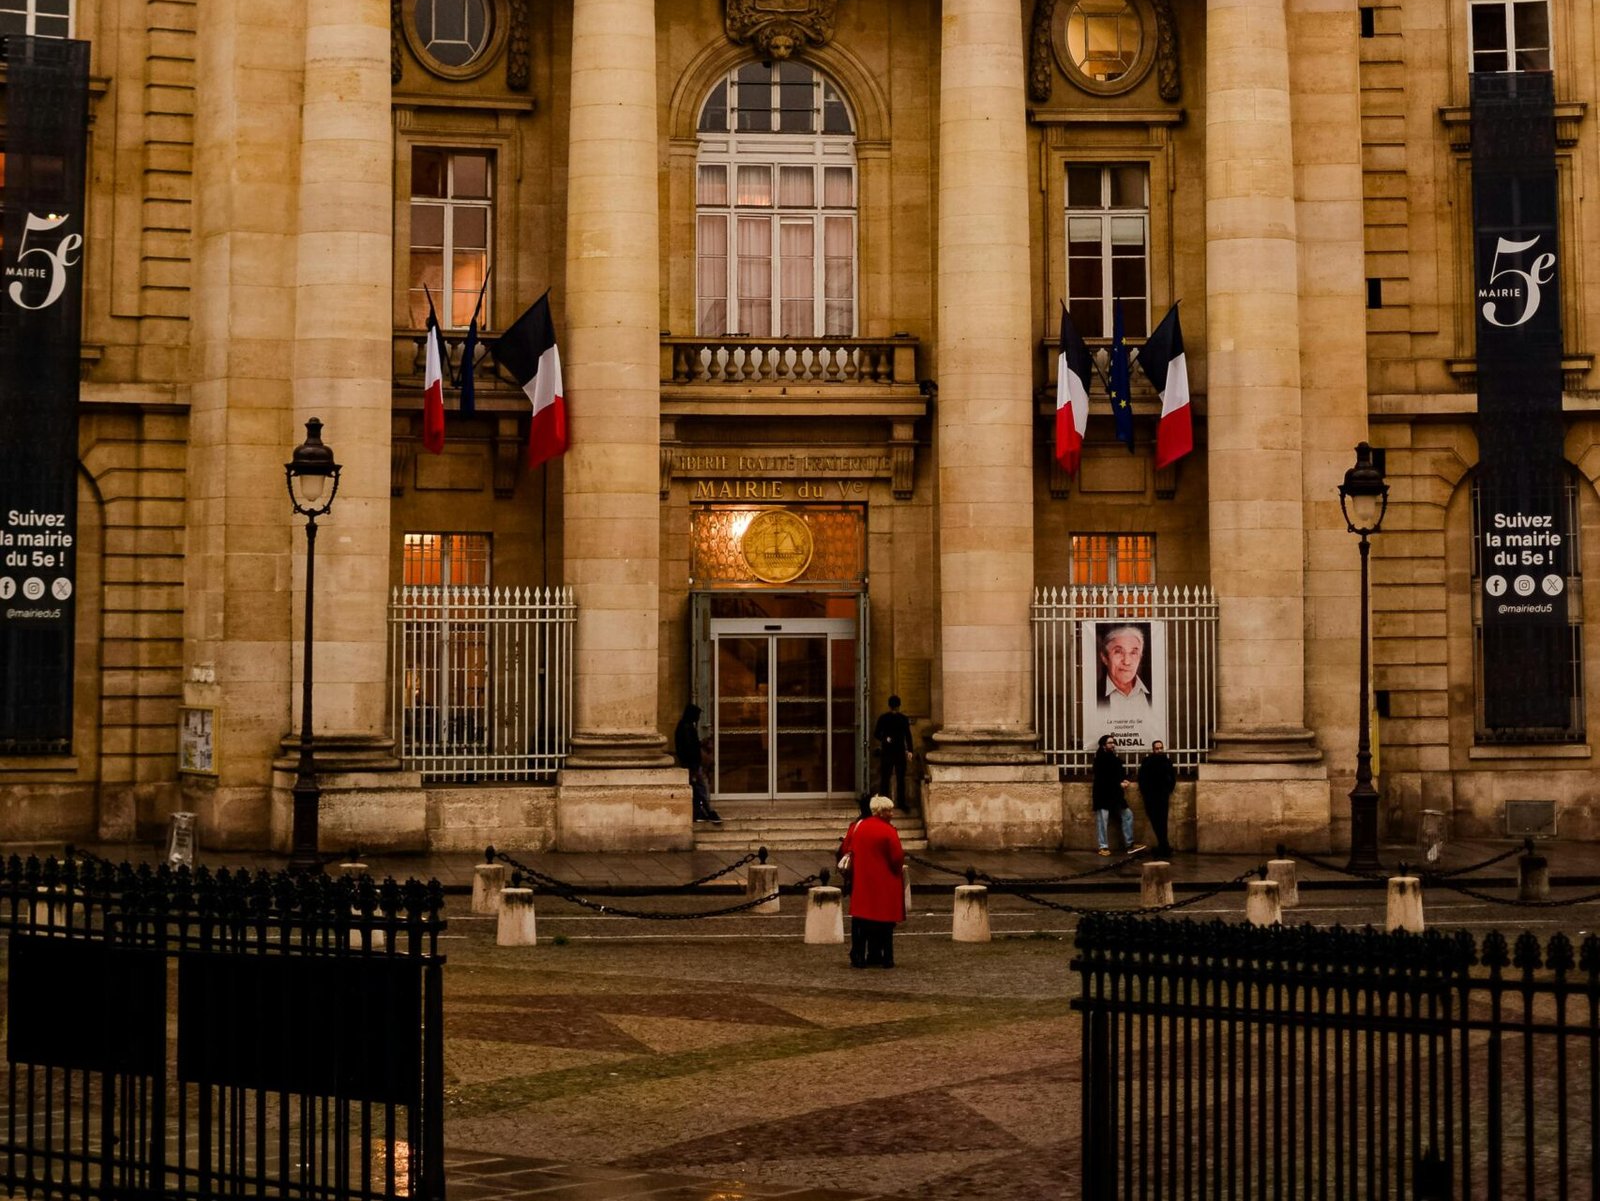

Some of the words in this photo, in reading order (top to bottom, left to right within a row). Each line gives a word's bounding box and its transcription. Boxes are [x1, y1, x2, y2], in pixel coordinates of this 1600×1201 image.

[5, 267, 46, 278] MAIRIE
[1478, 288, 1521, 298] MAIRIE
[695, 481, 784, 498] MAIRIE
[797, 481, 823, 498] du
[838, 481, 864, 498] Ve
[8, 510, 65, 526] Suivez
[1494, 512, 1552, 528] Suivez
[0, 530, 13, 546] la
[17, 530, 73, 547] mairie
[1486, 532, 1501, 547] la
[1506, 531, 1561, 546] mairie
[6, 551, 27, 566] du
[32, 551, 55, 567] 5e
[1494, 551, 1517, 565] du
[1521, 551, 1544, 565] 5e
[6, 608, 61, 619] @mairiedu5
[1498, 604, 1552, 614] @mairiedu5
[1112, 738, 1145, 746] ANSAL
